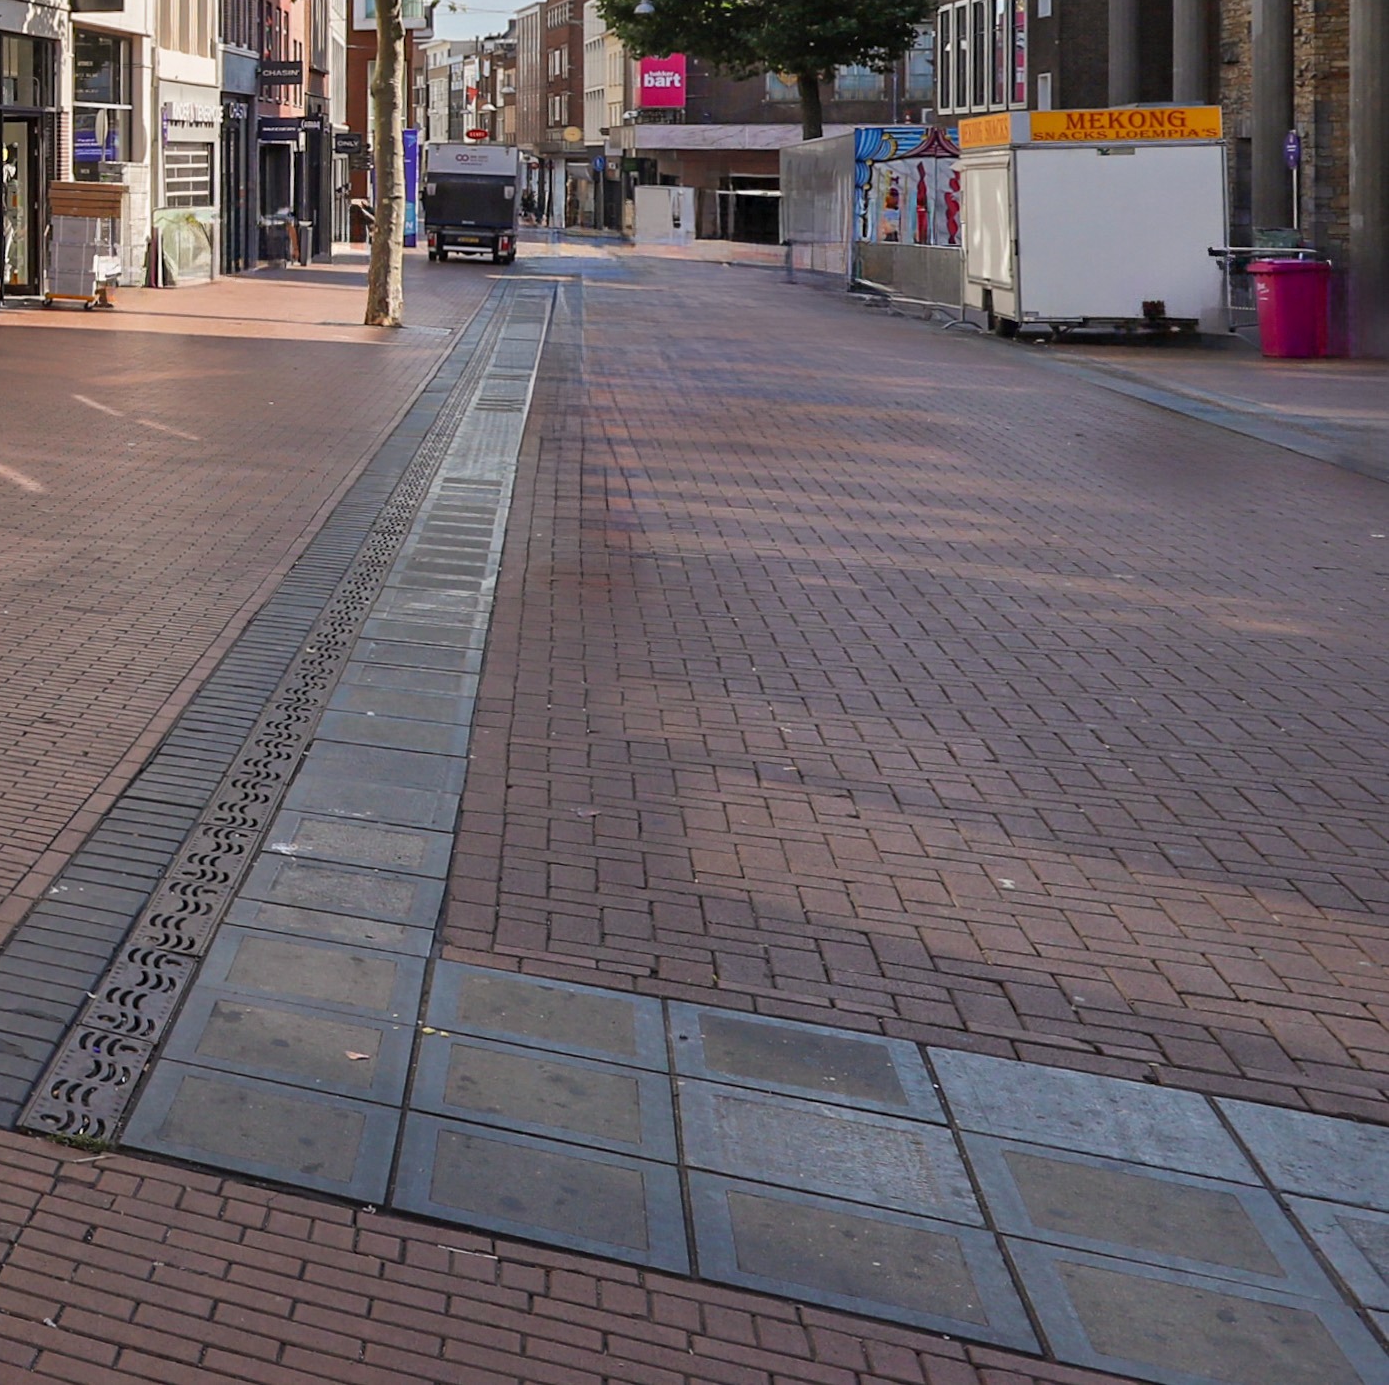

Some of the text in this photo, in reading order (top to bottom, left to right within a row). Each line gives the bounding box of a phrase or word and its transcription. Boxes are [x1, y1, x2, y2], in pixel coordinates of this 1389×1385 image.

[644, 73, 681, 87] bart
[1065, 110, 1187, 130] MEKONG
[1033, 128, 1218, 141] SNACKS LOEMPIA'S
